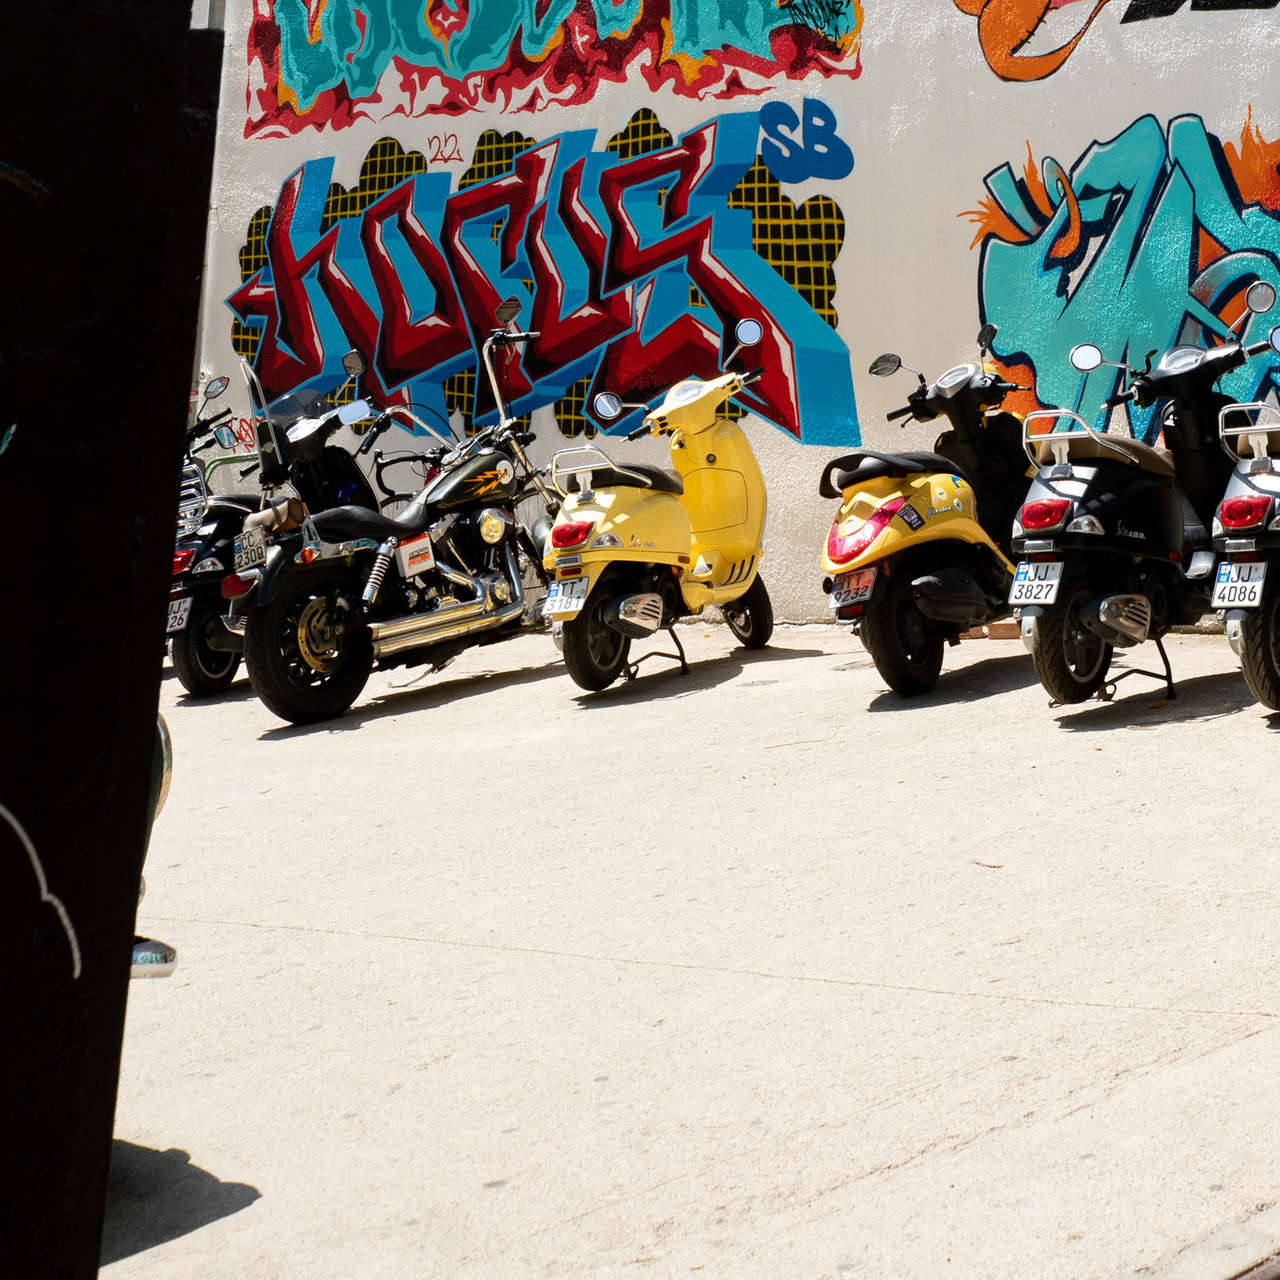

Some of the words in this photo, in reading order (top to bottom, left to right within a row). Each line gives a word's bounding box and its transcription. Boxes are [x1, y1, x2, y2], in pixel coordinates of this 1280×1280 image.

[427, 133, 464, 164] 22
[758, 97, 855, 185] SB
[1028, 564, 1050, 581] JJ
[1230, 565, 1253, 583] JJ
[561, 581, 577, 596] TT
[1014, 583, 1054, 600] 3827
[1217, 585, 1257, 603] 4086
[546, 596, 580, 612] 3181
